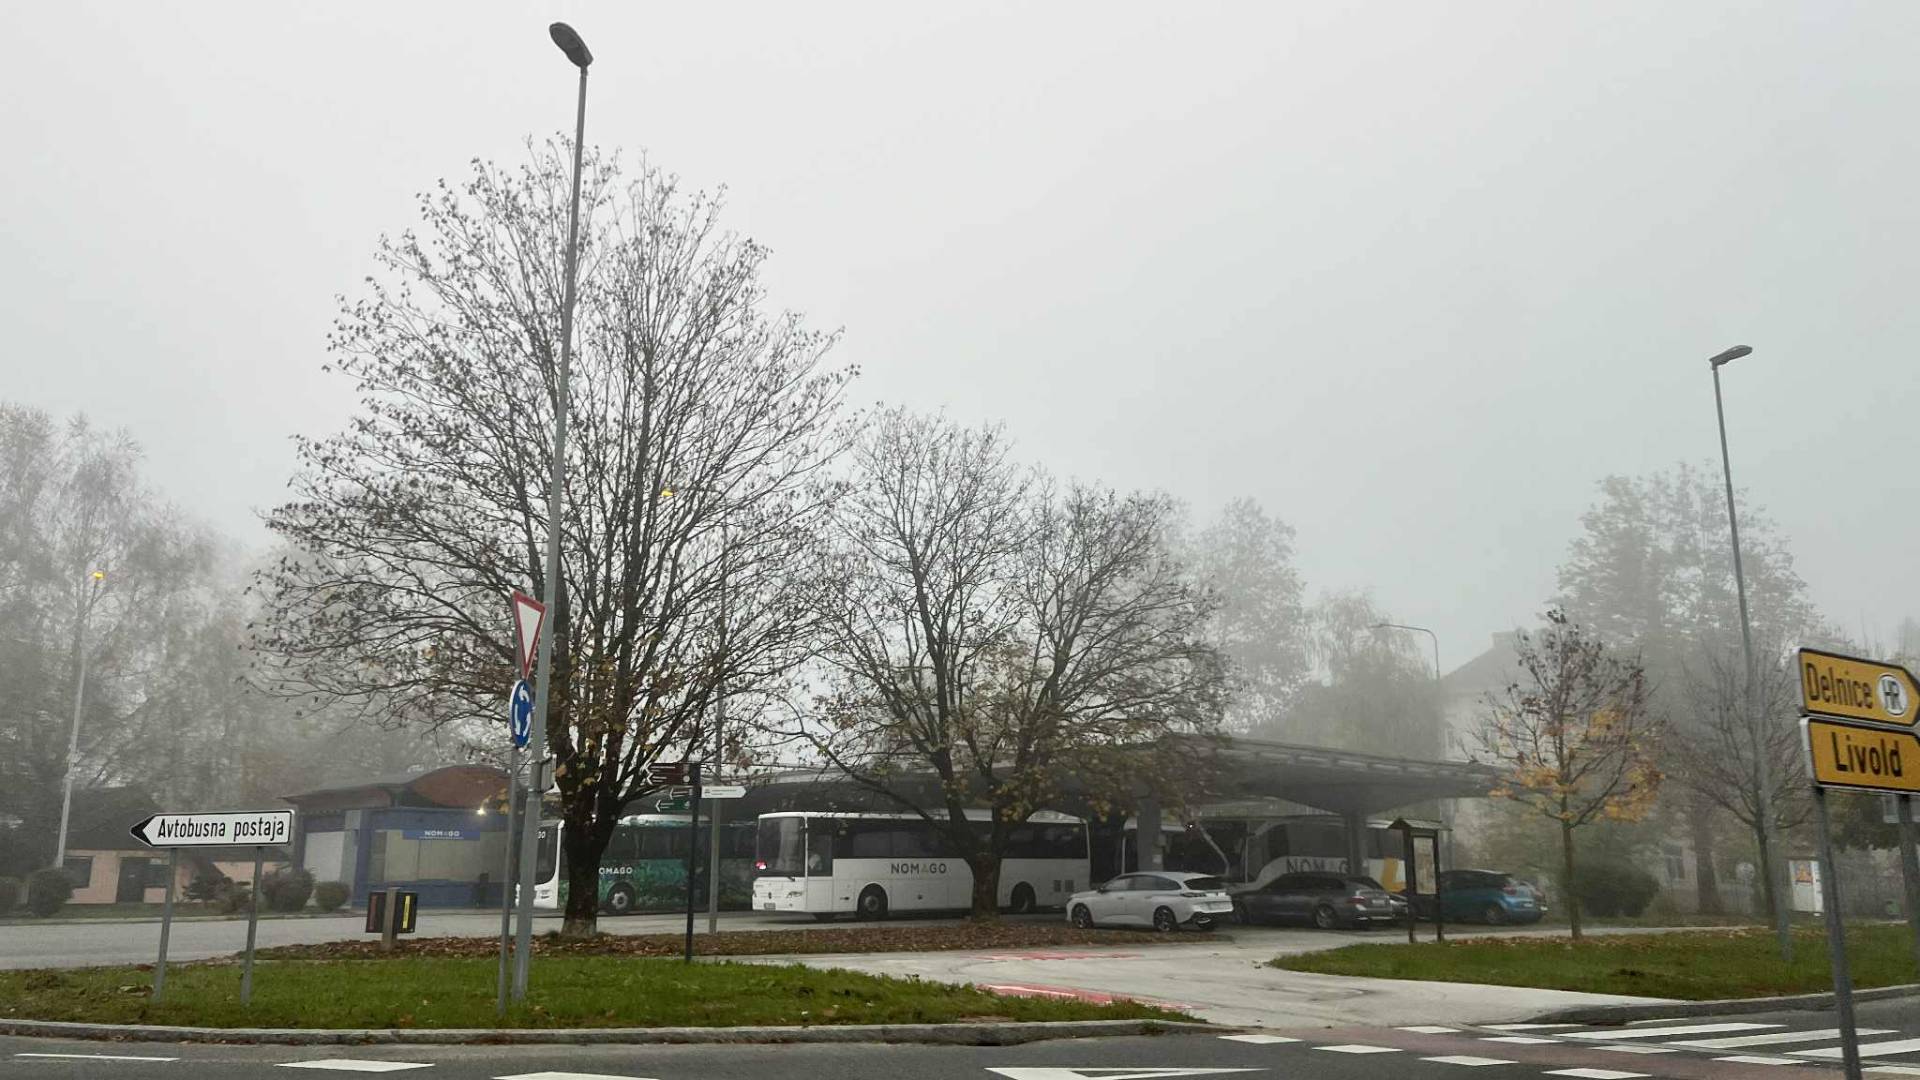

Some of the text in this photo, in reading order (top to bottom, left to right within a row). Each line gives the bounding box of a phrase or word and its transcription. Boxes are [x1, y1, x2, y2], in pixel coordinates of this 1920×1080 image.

[1805, 662, 1873, 709] Delnice
[1831, 731, 1903, 777] Livold
[157, 816, 284, 842] Avtobusna postaja
[598, 866, 633, 875] OMAGO
